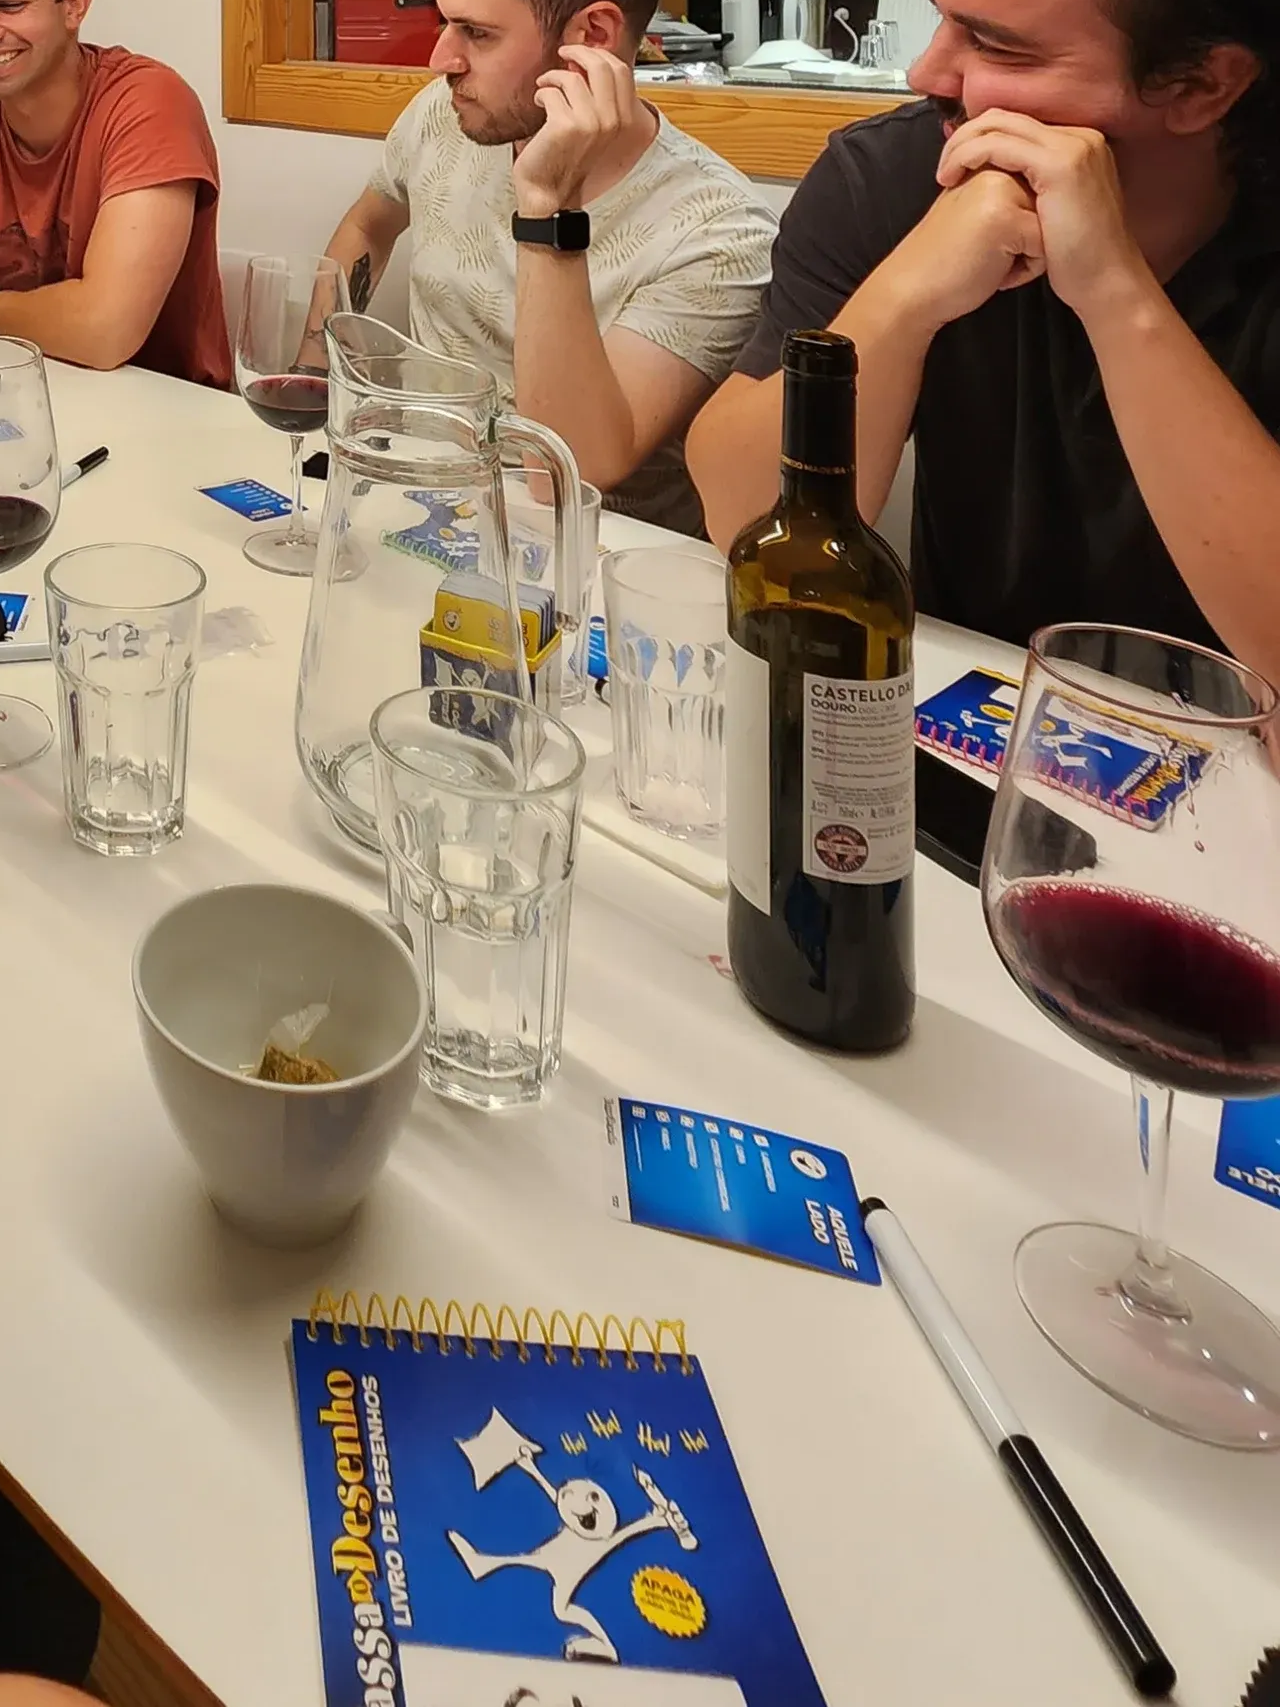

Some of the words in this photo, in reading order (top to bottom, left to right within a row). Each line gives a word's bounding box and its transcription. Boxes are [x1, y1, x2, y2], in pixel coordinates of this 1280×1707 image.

[811, 684, 893, 703] CASTELLO
[811, 699, 857, 714] DOURO
[804, 1197, 830, 1245] LADO
[825, 1203, 859, 1272] AQUELE
[361, 1374, 394, 1505] DESENHOS
[378, 1509, 400, 1544] DE
[385, 1549, 413, 1628] LIVRO
